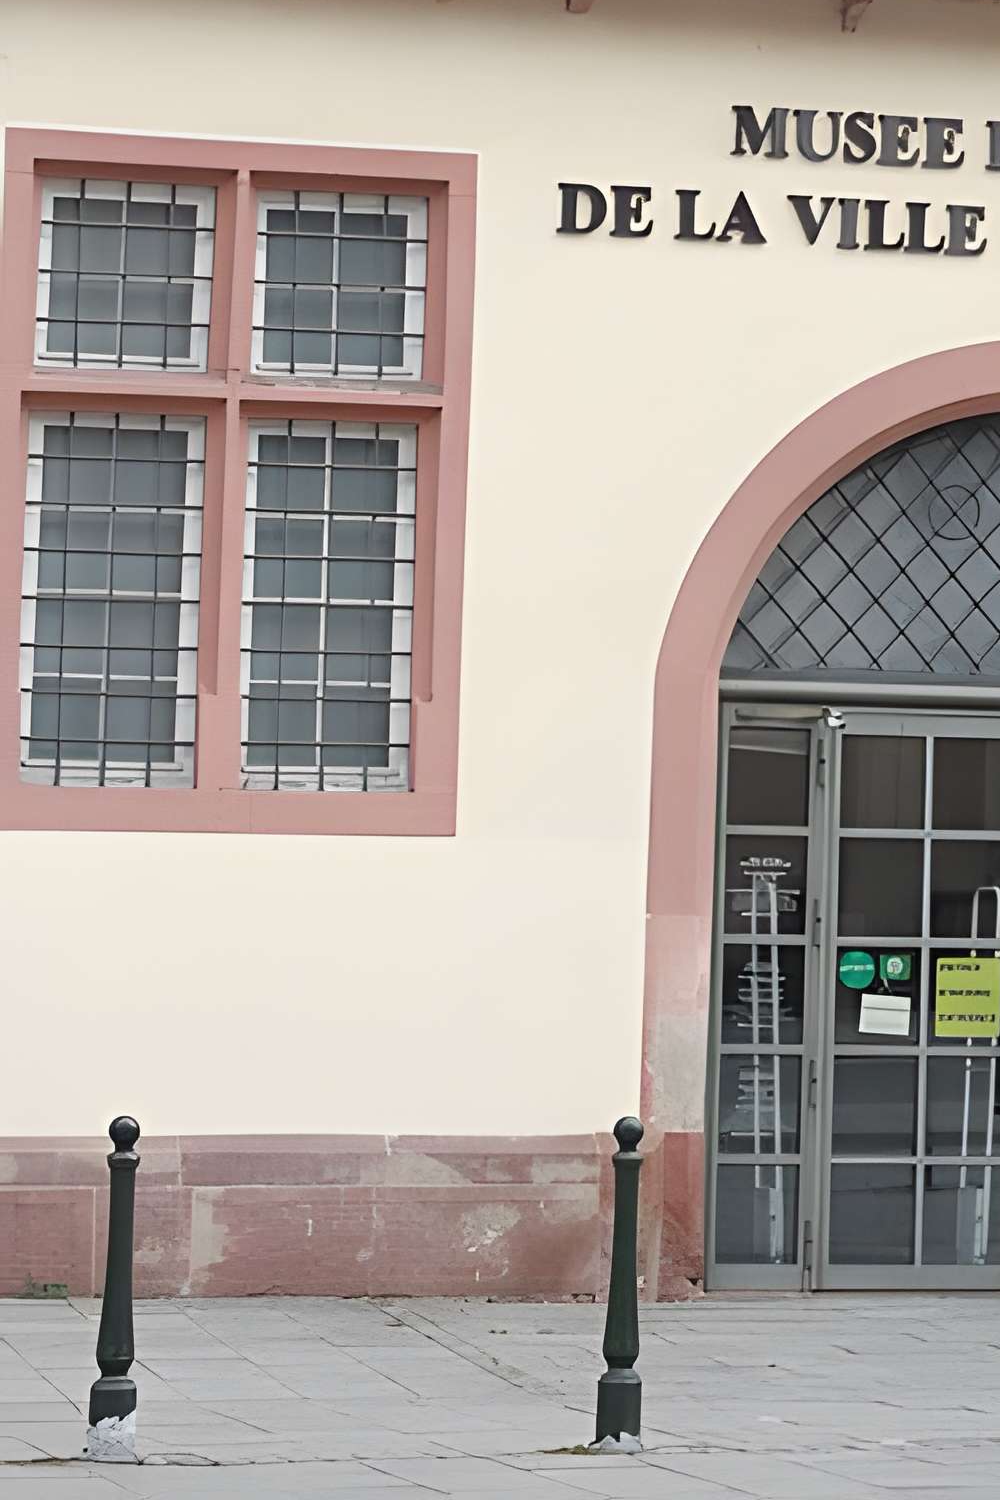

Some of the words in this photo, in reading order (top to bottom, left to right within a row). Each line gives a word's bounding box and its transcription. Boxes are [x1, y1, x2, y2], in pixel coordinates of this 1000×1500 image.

[730, 105, 965, 169] MUSEE
[556, 182, 654, 238] DE
[674, 189, 767, 244] LA
[787, 194, 988, 257] VILLE
